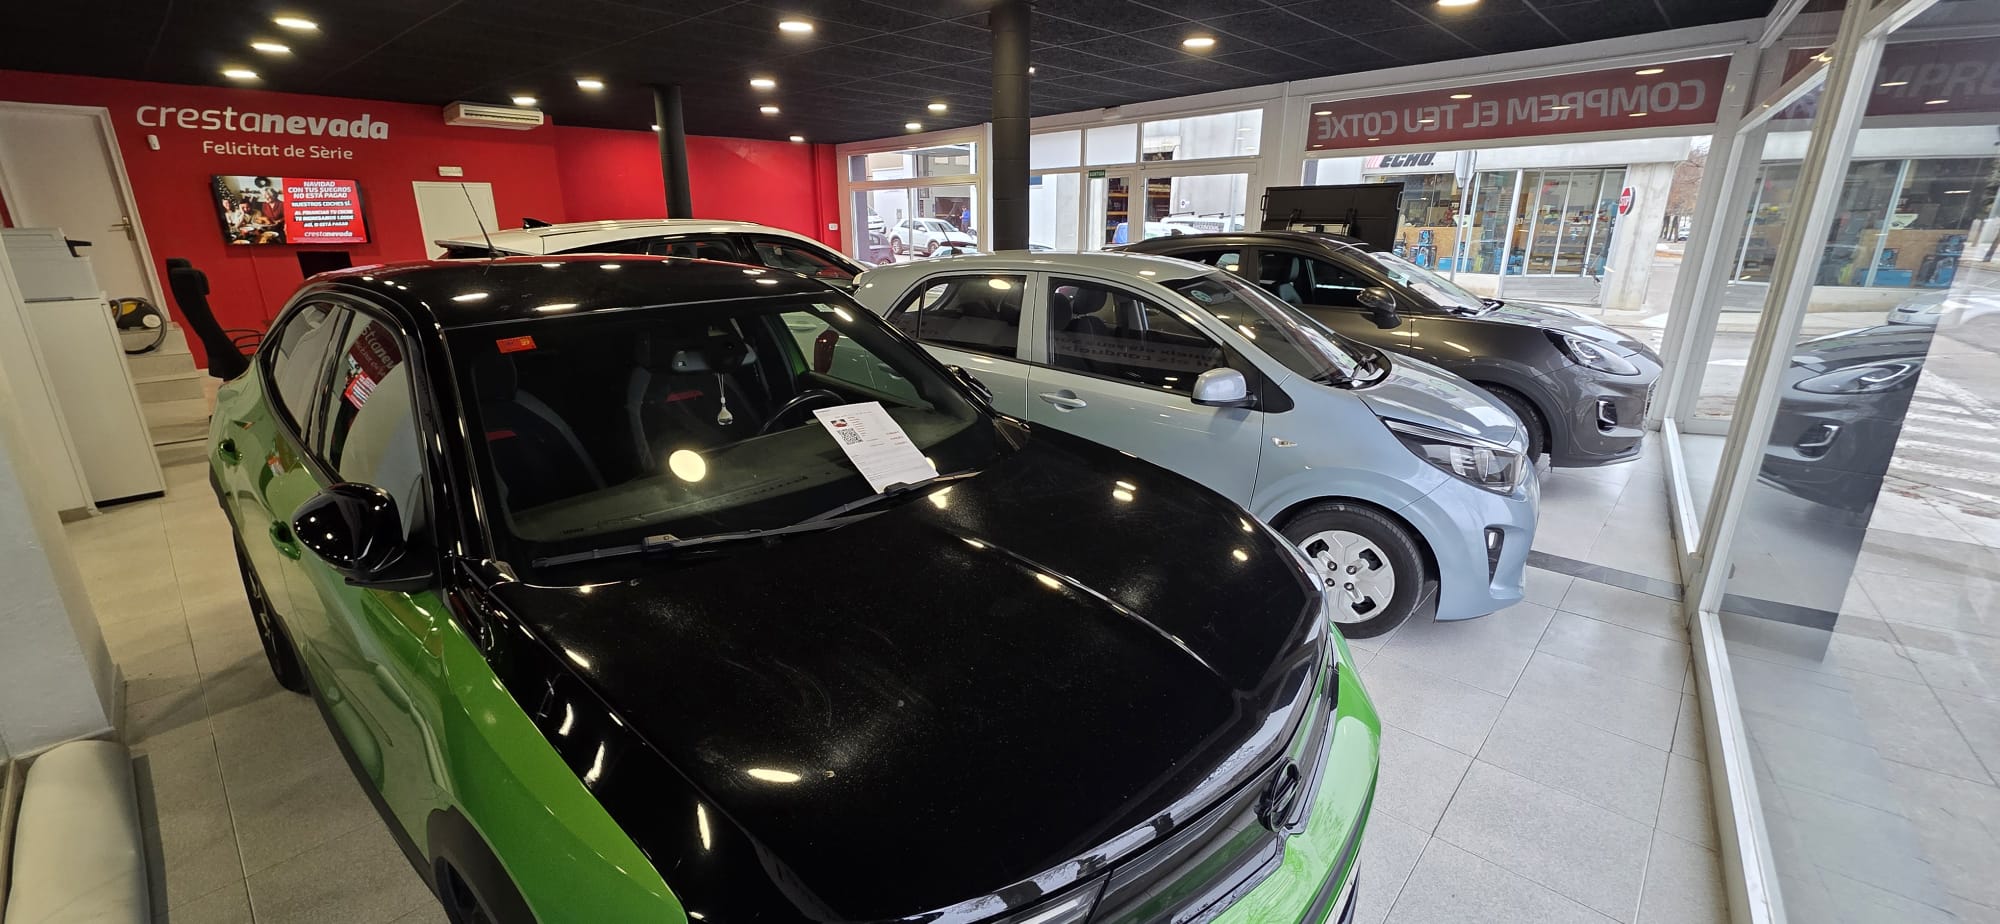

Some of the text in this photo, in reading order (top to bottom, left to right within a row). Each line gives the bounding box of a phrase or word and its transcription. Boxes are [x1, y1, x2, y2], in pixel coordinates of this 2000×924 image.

[136, 105, 389, 140] crestanevada
[202, 140, 353, 160] Felicitat de Sèrie
